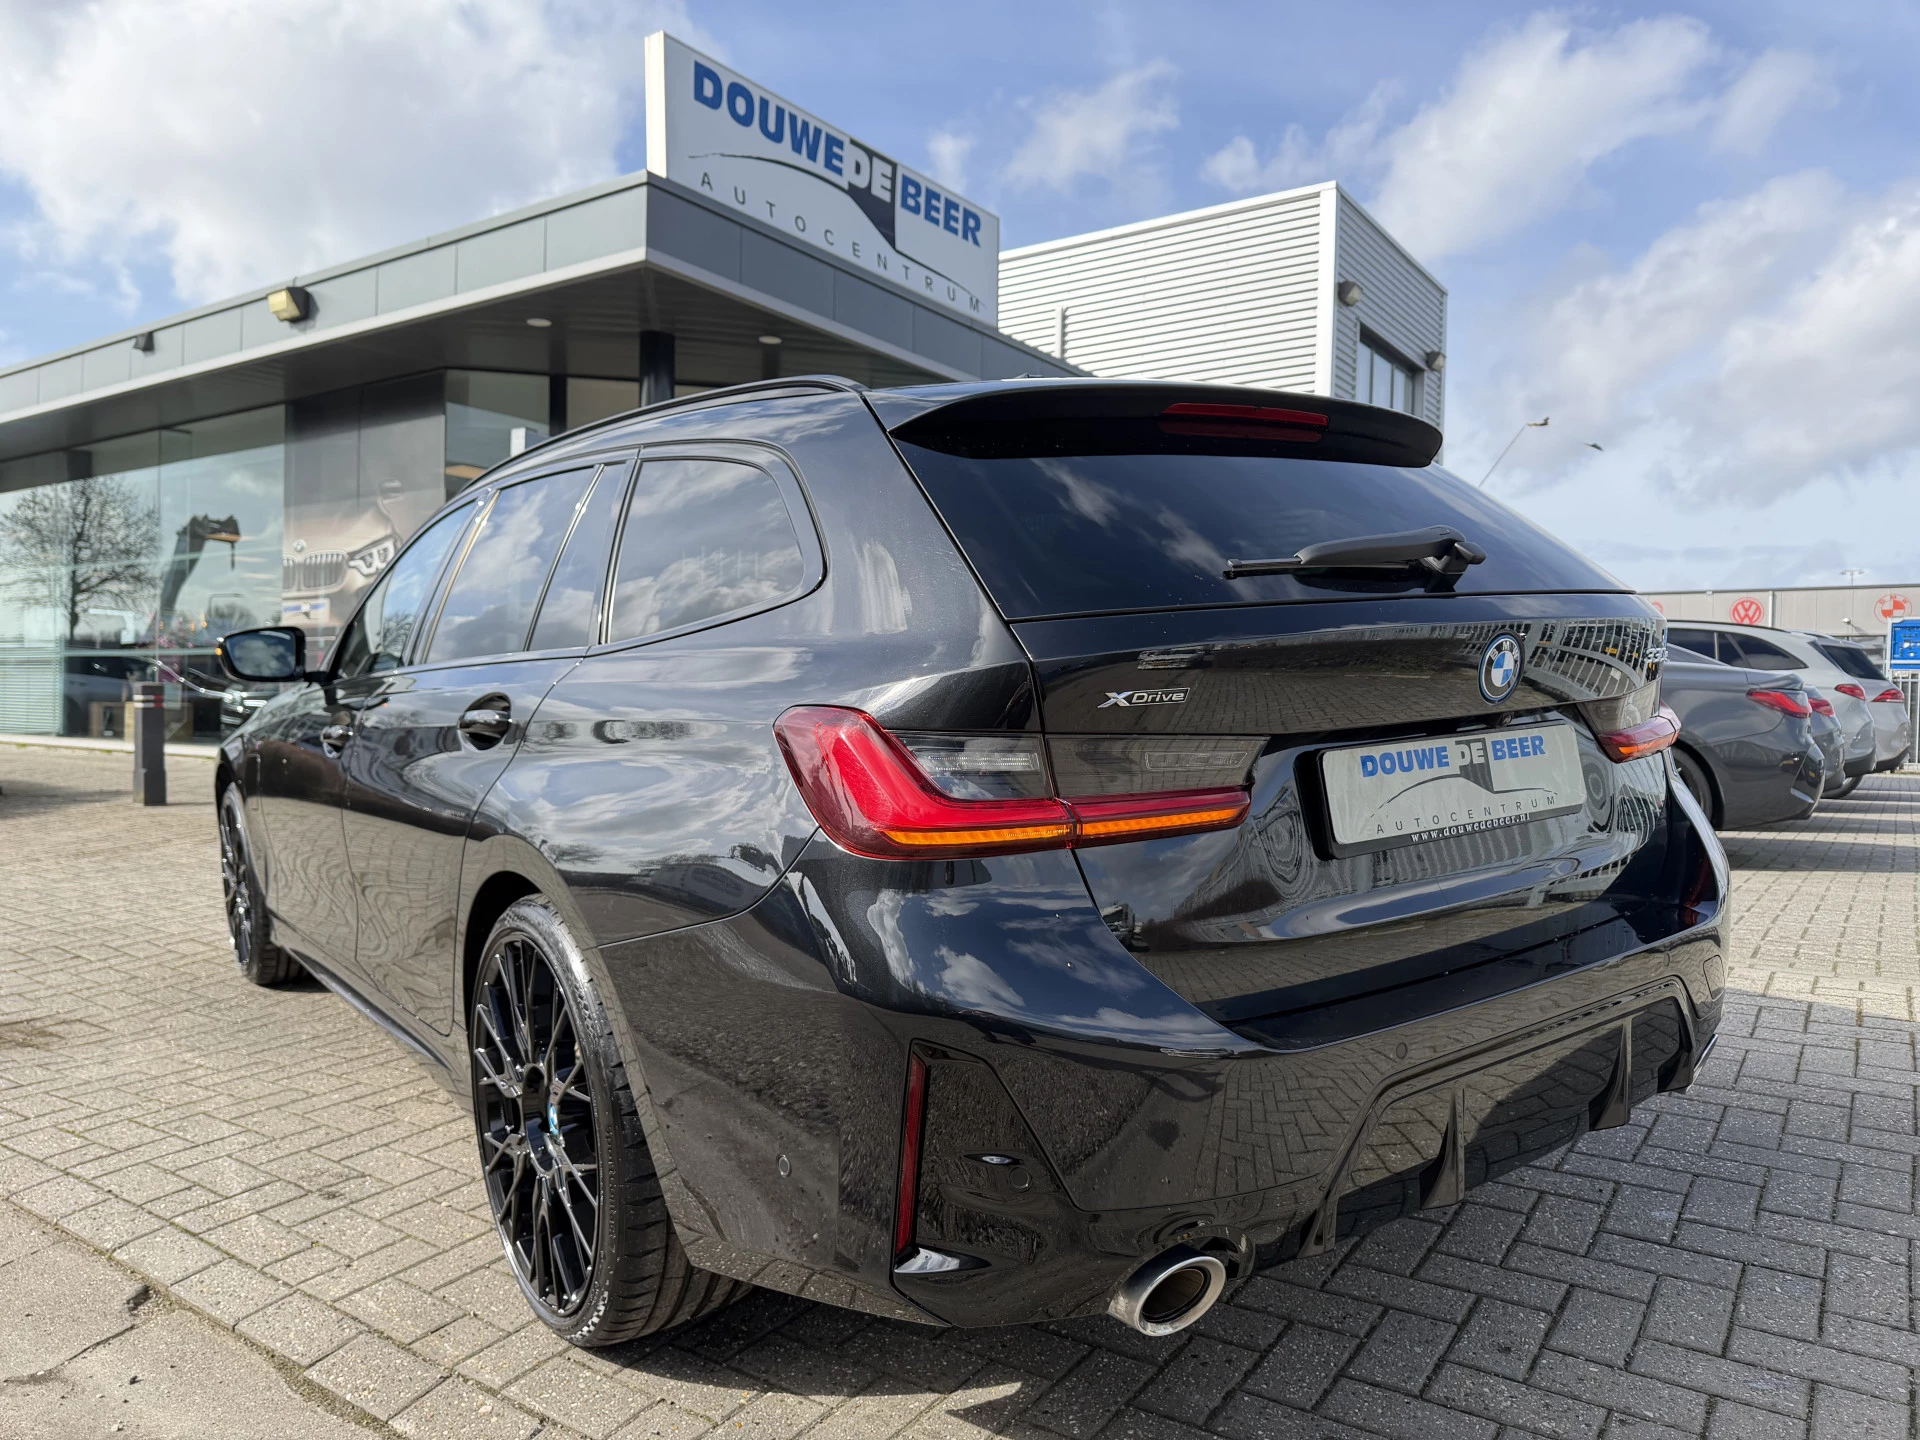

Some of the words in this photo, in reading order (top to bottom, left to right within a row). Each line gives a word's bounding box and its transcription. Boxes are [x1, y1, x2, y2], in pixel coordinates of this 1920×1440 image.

[694, 60, 844, 177] DOUWE
[847, 141, 893, 203] DE
[901, 173, 981, 248] BEER
[701, 171, 980, 313] AUTOCENTRUM
[1360, 746, 1450, 778] DOUWE
[1454, 741, 1485, 767] DE
[1491, 735, 1546, 761] BEER
[1376, 796, 1555, 834] AUTOCENTRUM
[1411, 812, 1531, 843] www.douwedebeer.nl
